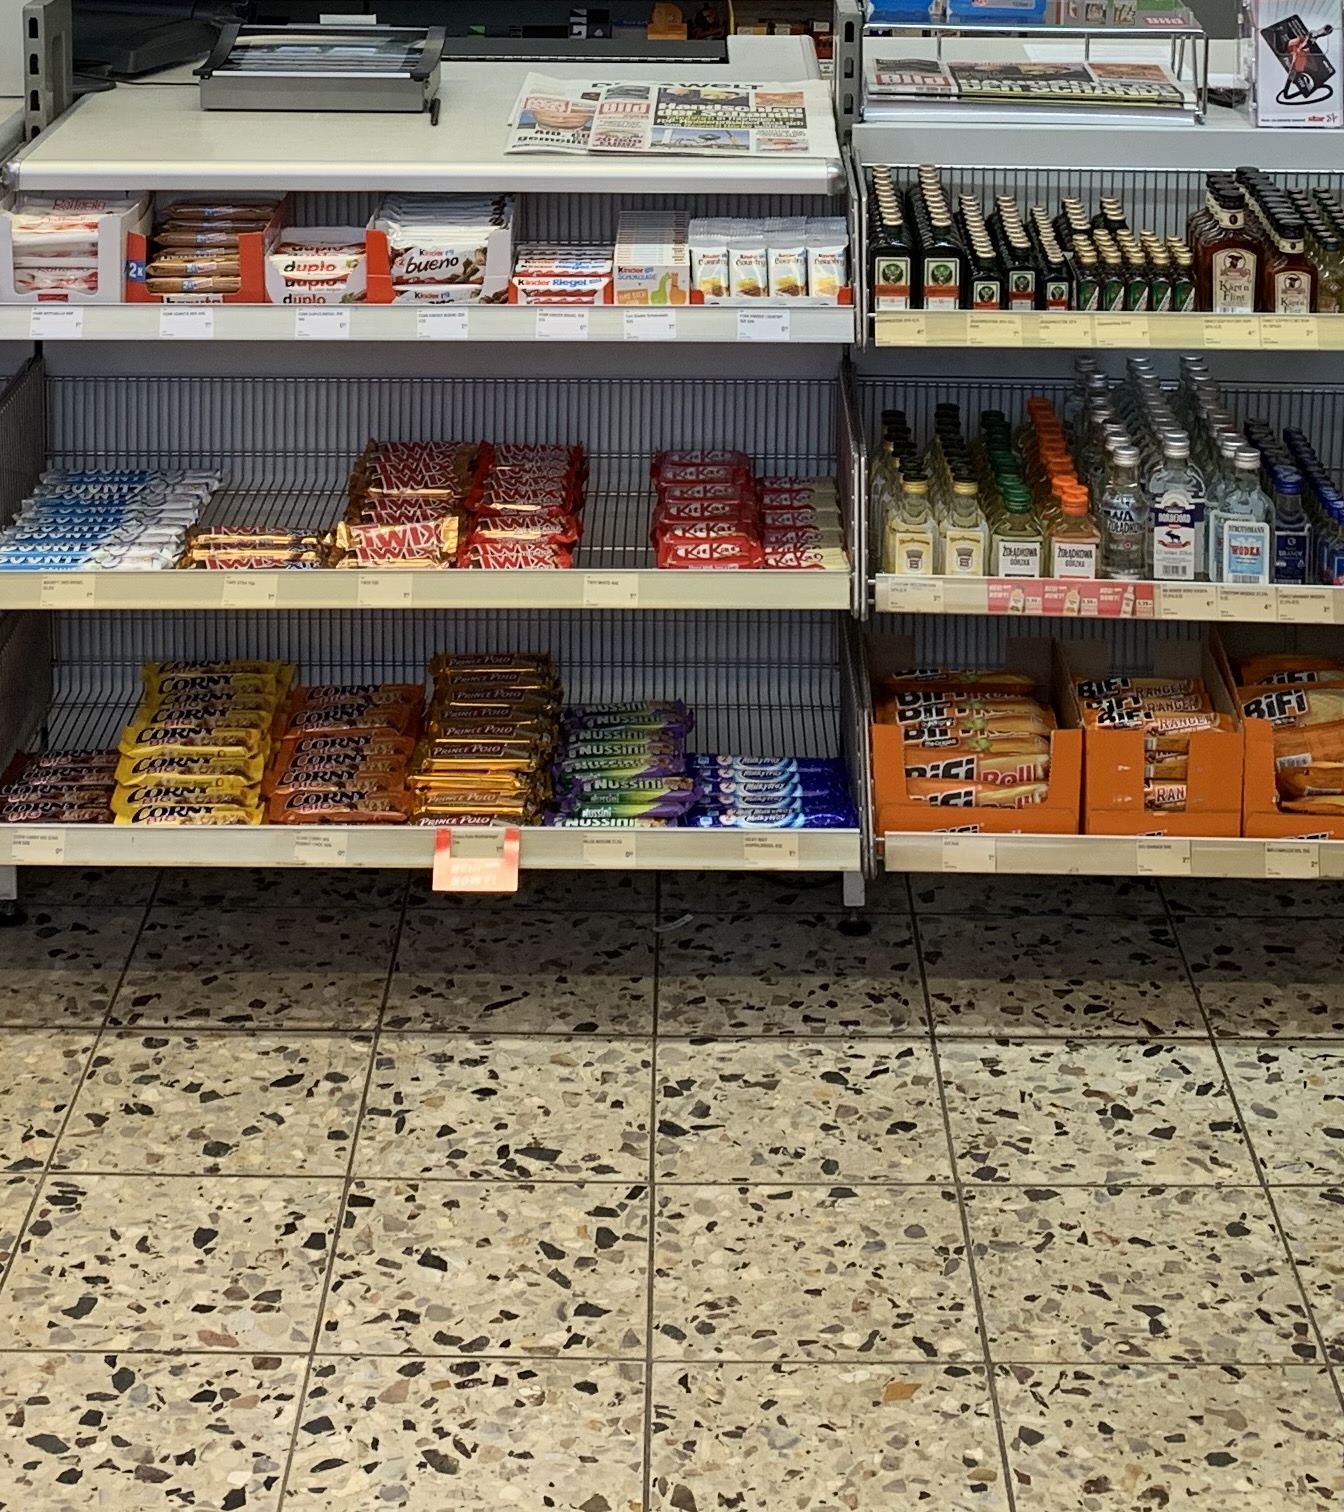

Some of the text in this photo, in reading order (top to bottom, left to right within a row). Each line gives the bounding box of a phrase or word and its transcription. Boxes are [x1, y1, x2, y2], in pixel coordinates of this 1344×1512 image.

[283, 259, 337, 276] duplo
[405, 255, 459, 275] bueno
[552, 276, 588, 289] Riegel
[430, 743, 501, 756] PRINCE POLO
[132, 756, 210, 773] CORNY
